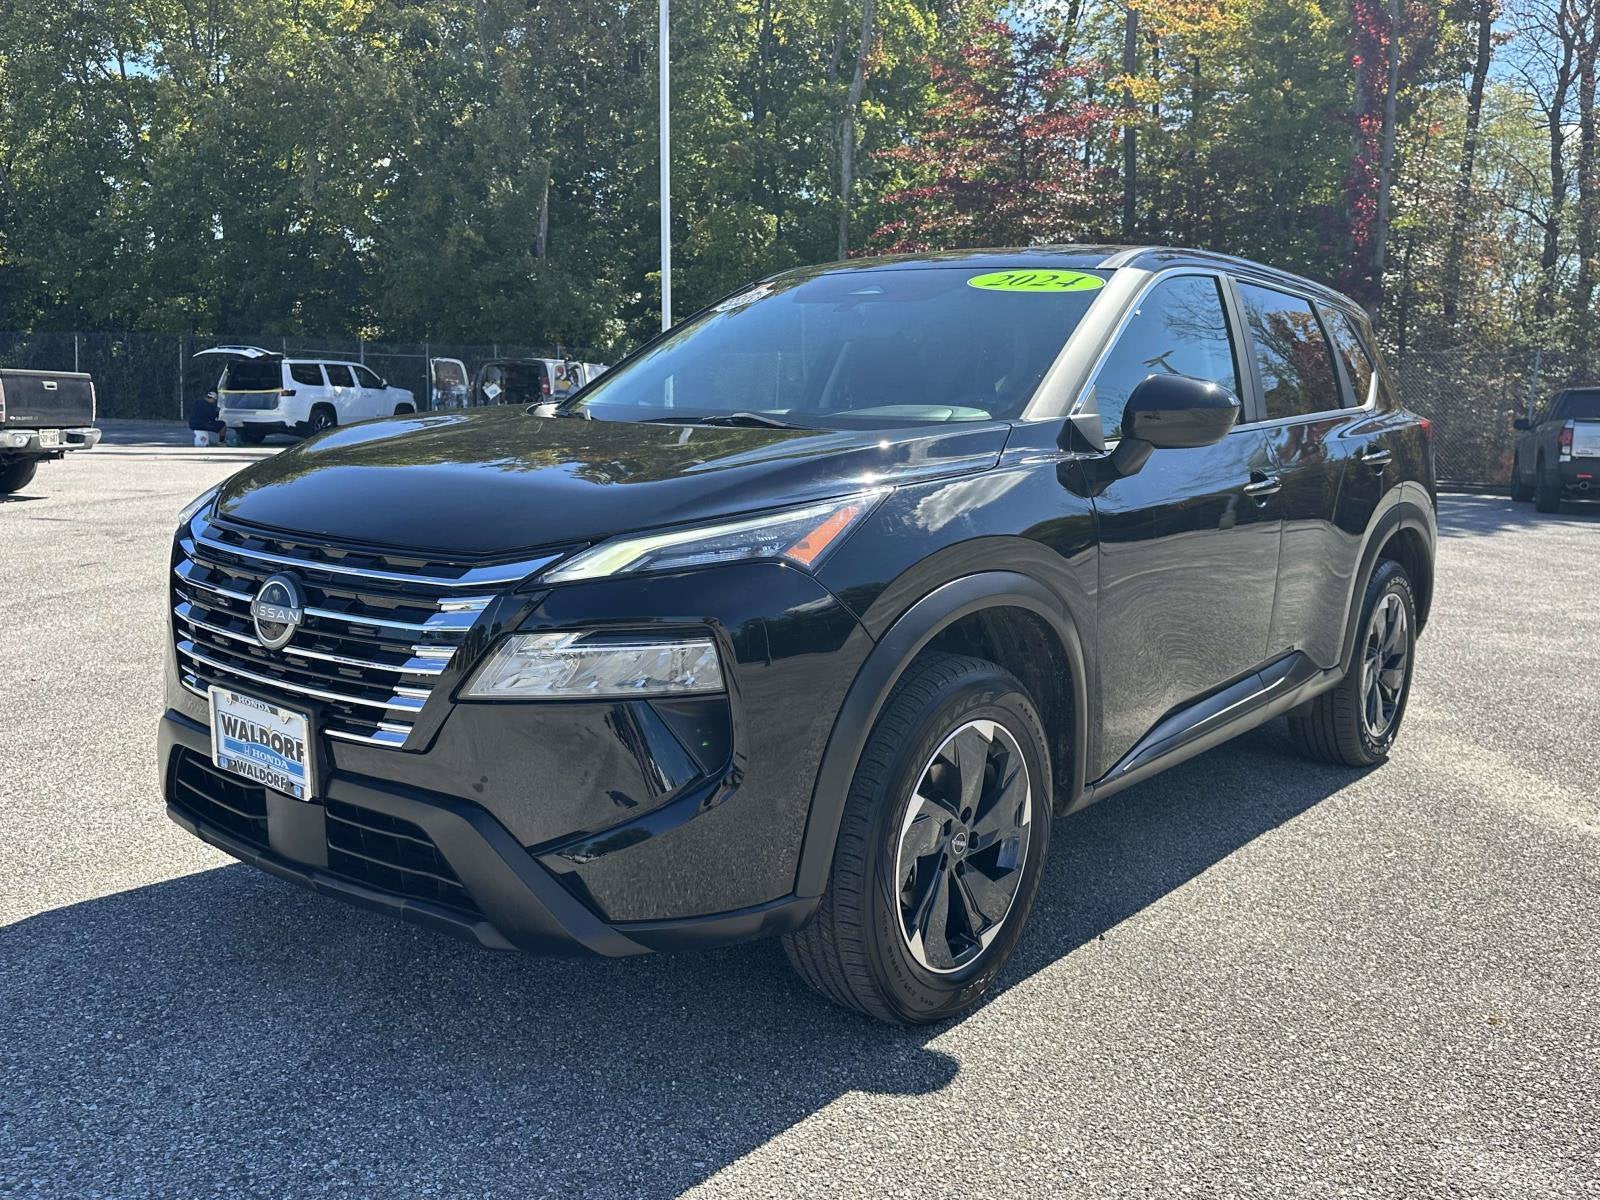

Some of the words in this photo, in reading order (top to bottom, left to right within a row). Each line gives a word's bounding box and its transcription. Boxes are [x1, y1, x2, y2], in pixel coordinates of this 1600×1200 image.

[984, 274, 1086, 287] 2024
[252, 604, 299, 621] NISSAN
[238, 695, 270, 713] HONDA
[220, 713, 304, 762] WALDORF
[252, 748, 289, 769] HONDA
[235, 759, 288, 788] WALDORF
